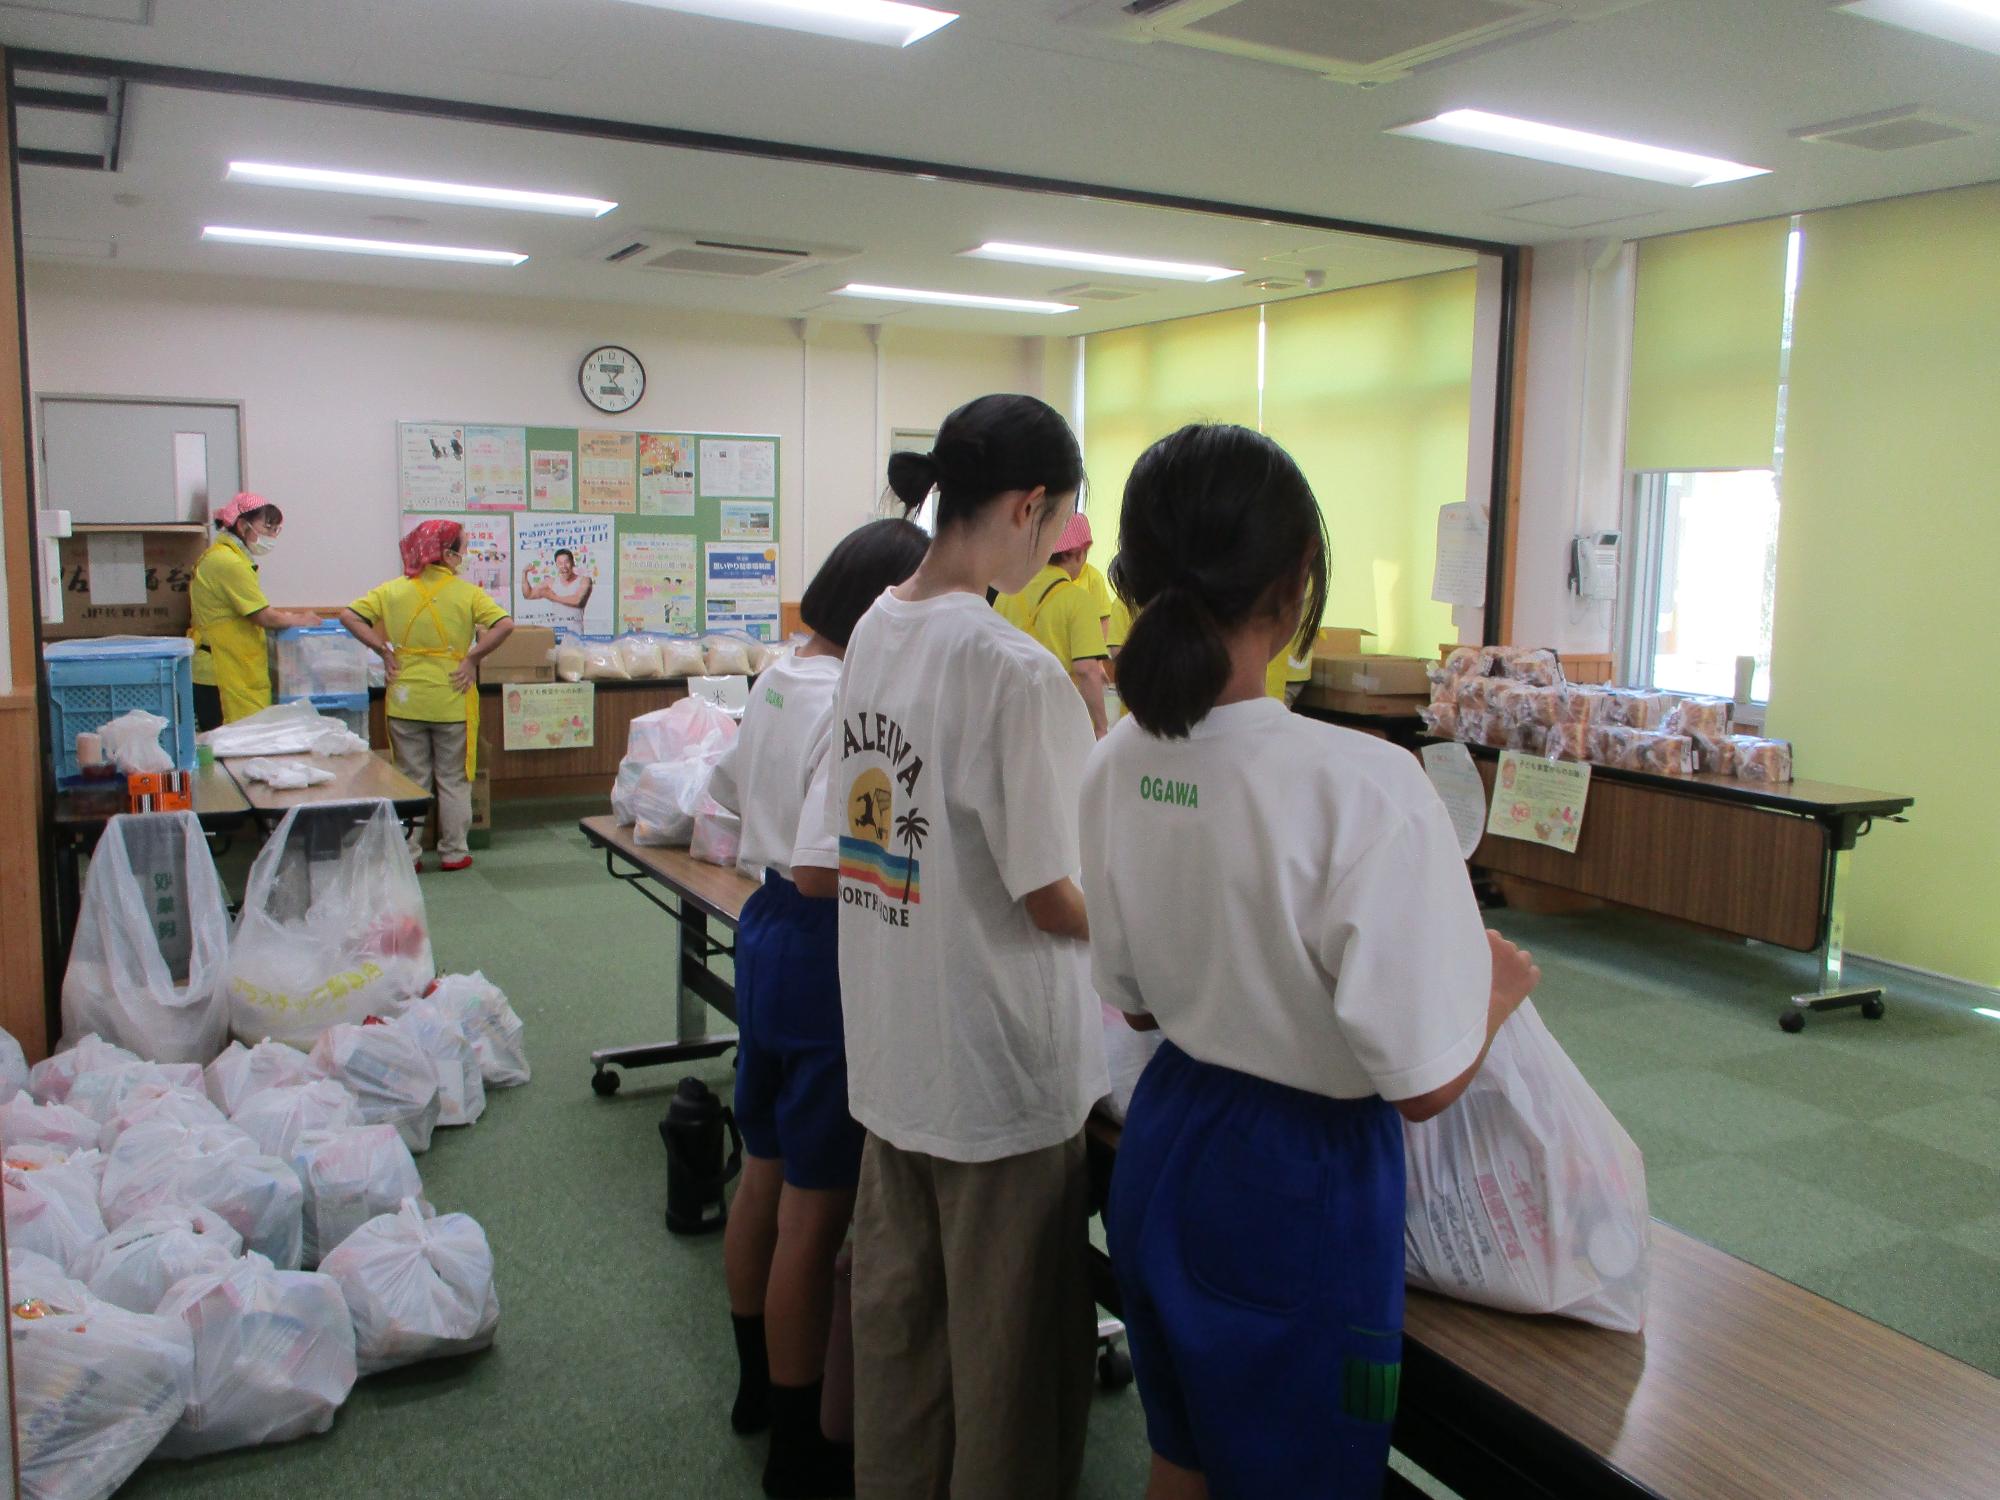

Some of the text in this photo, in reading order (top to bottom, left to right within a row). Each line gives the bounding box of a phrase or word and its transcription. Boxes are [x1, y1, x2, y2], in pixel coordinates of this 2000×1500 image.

[712, 689, 726, 704] 米
[841, 712, 923, 799] ALEIWA
[1140, 775, 1198, 808] OGAWA
